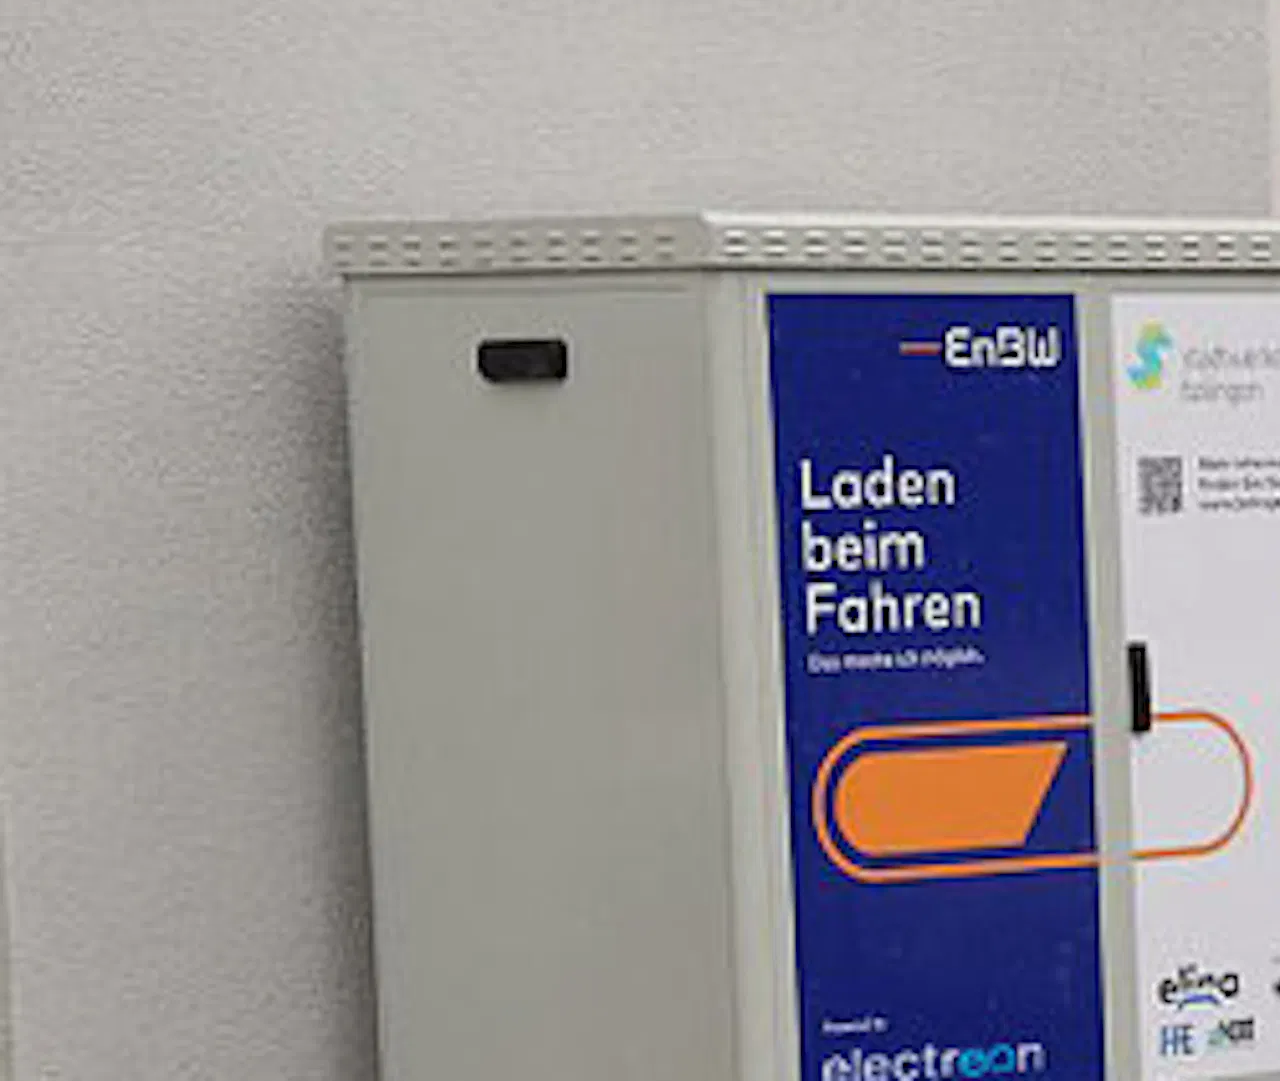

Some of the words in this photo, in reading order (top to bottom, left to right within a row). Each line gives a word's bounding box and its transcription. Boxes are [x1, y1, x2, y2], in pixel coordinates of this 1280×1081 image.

[944, 326, 1062, 367] EnBW
[800, 453, 956, 510] Laden
[801, 519, 925, 572] beim
[805, 579, 982, 635] Fahren
